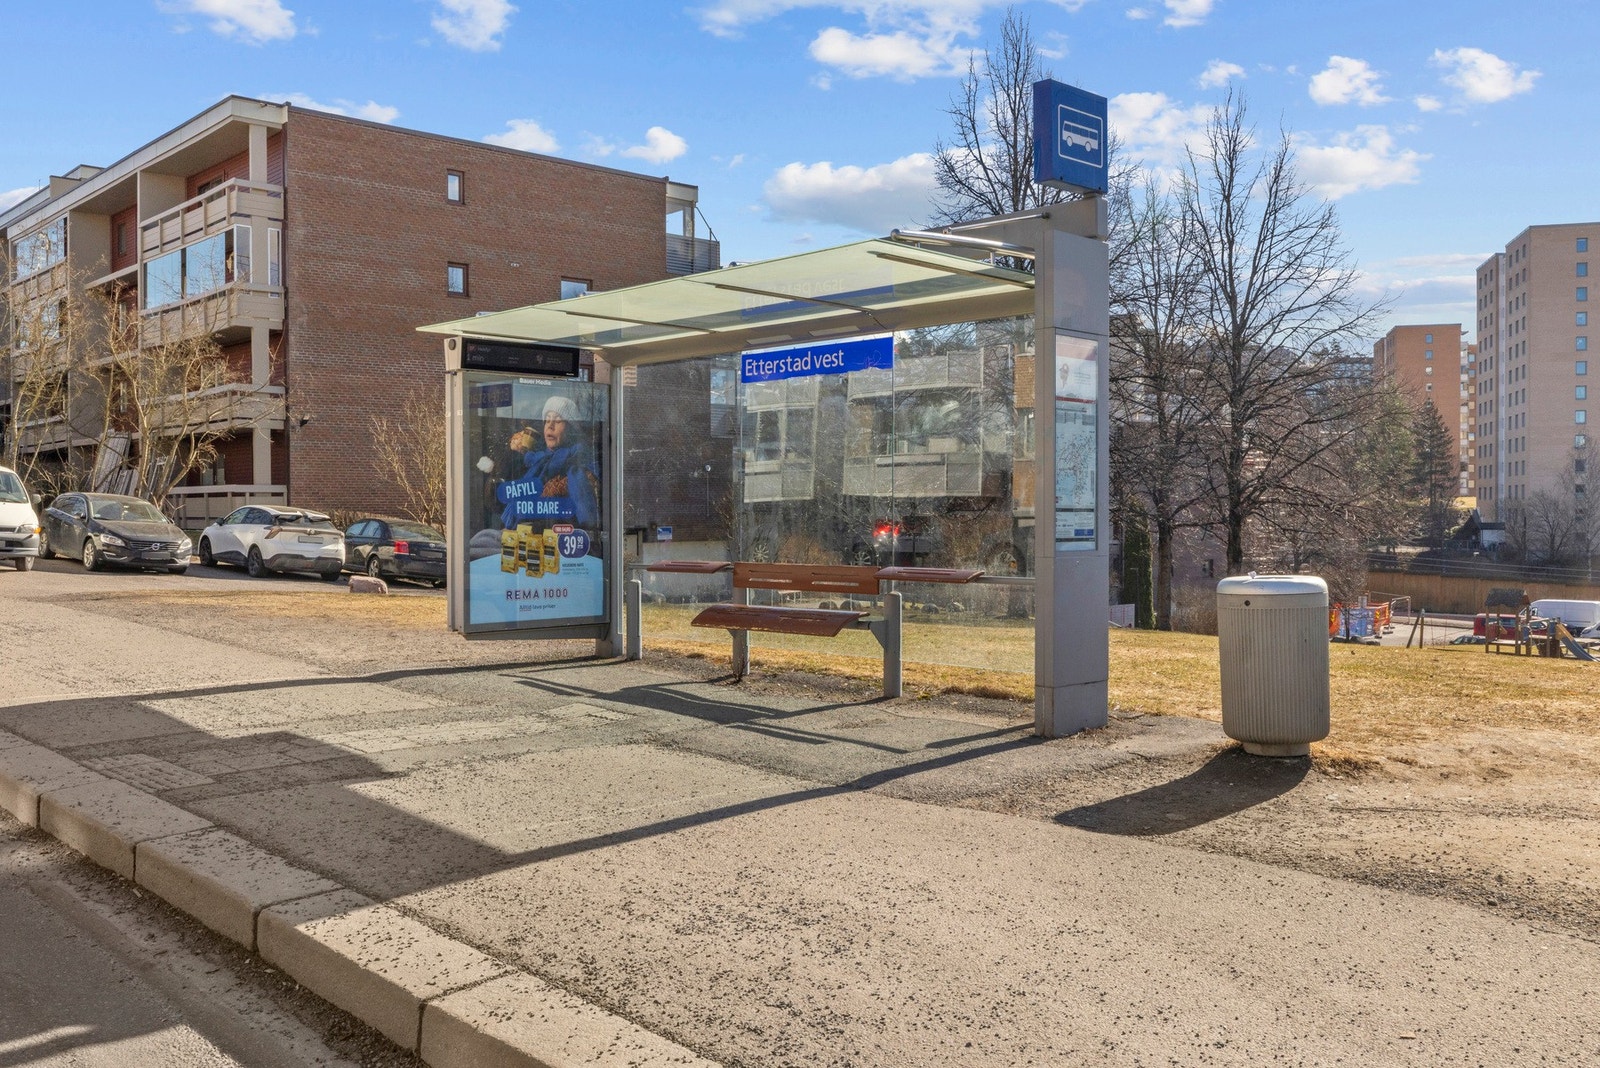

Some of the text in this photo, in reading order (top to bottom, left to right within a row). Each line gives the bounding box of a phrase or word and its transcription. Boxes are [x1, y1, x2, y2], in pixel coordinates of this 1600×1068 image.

[745, 349, 844, 376] Etterstad vest
[505, 480, 538, 499] PÅFYLL
[516, 501, 534, 514] FOR
[537, 501, 560, 514] BARE
[563, 535, 577, 555] 39
[506, 588, 568, 600] REMA 1000
